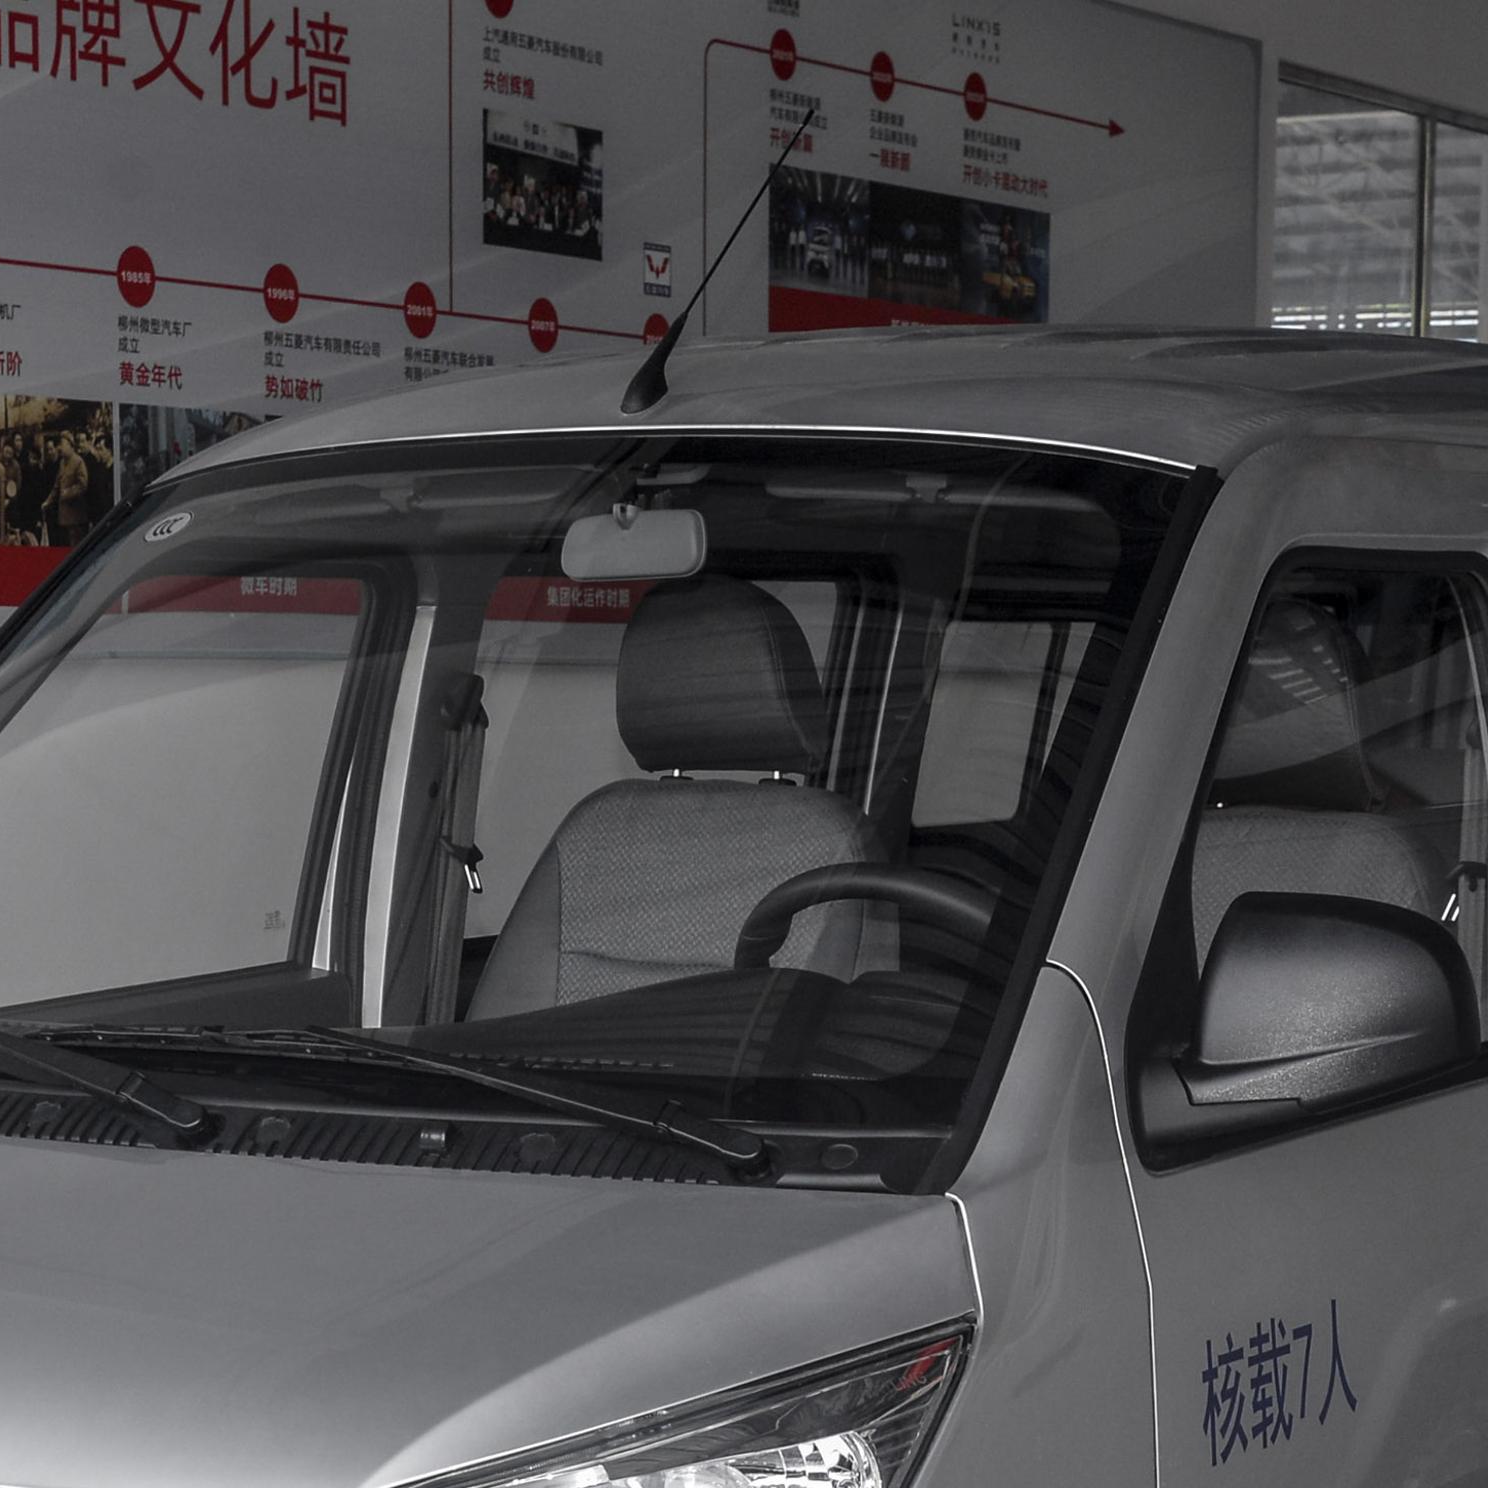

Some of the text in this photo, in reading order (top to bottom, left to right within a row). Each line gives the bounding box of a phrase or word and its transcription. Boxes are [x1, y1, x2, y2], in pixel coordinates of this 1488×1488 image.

[117, 315, 193, 337] 柳州微型汽车厂
[118, 337, 140, 354] 成立
[264, 352, 284, 368] 成立
[119, 361, 183, 390] 黄金年代
[264, 375, 323, 402] 势如破竹
[1201, 1299, 1358, 1466] 核载7人
